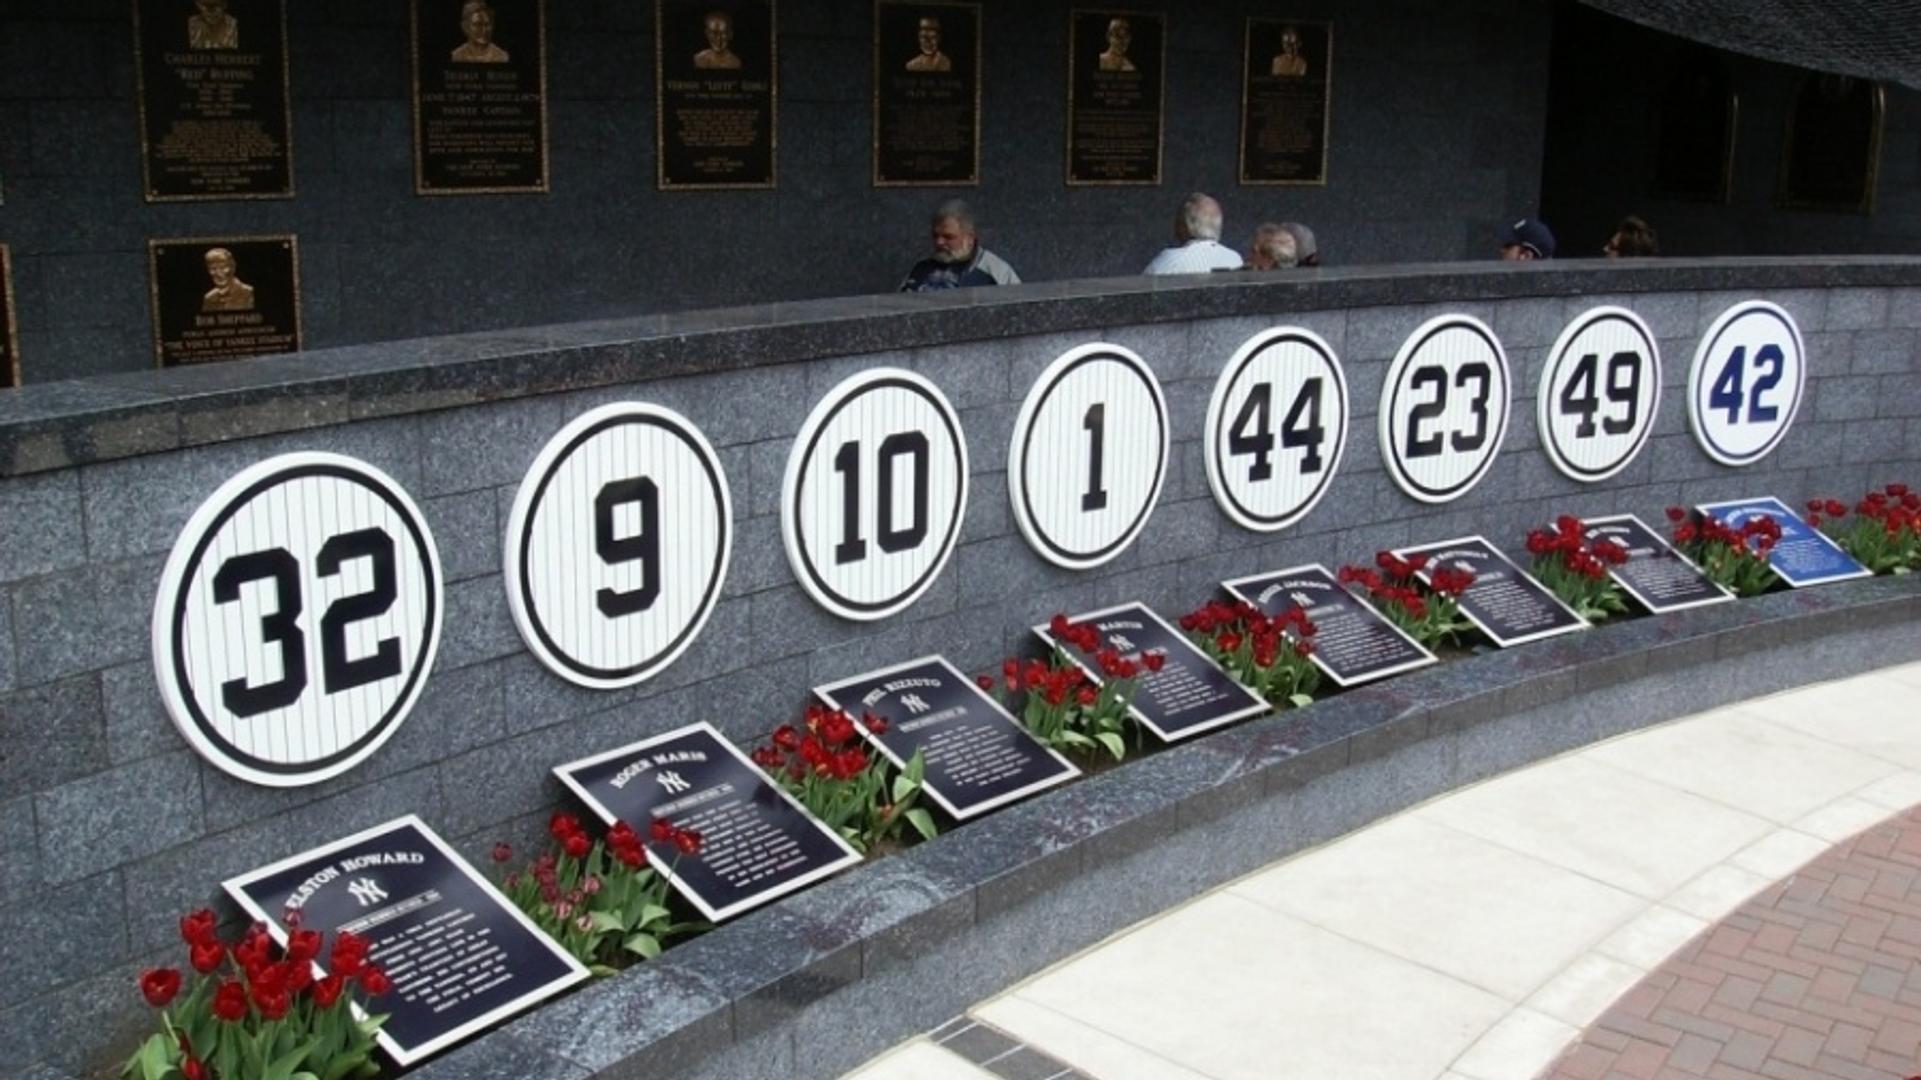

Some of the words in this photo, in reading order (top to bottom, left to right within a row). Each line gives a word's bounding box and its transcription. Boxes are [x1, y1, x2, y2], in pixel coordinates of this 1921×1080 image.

[1229, 378, 1324, 482] 44
[1406, 362, 1490, 458] 23
[1561, 351, 1641, 438] 49
[1710, 345, 1784, 423] 42
[835, 431, 929, 564] 10
[1082, 404, 1106, 511] 1
[595, 476, 660, 618] 9
[213, 527, 401, 718] 32
[608, 758, 655, 789] ROGER
[652, 750, 708, 765] MARIS
[284, 865, 341, 909] ELSTON
[339, 851, 425, 872] HOWARD
